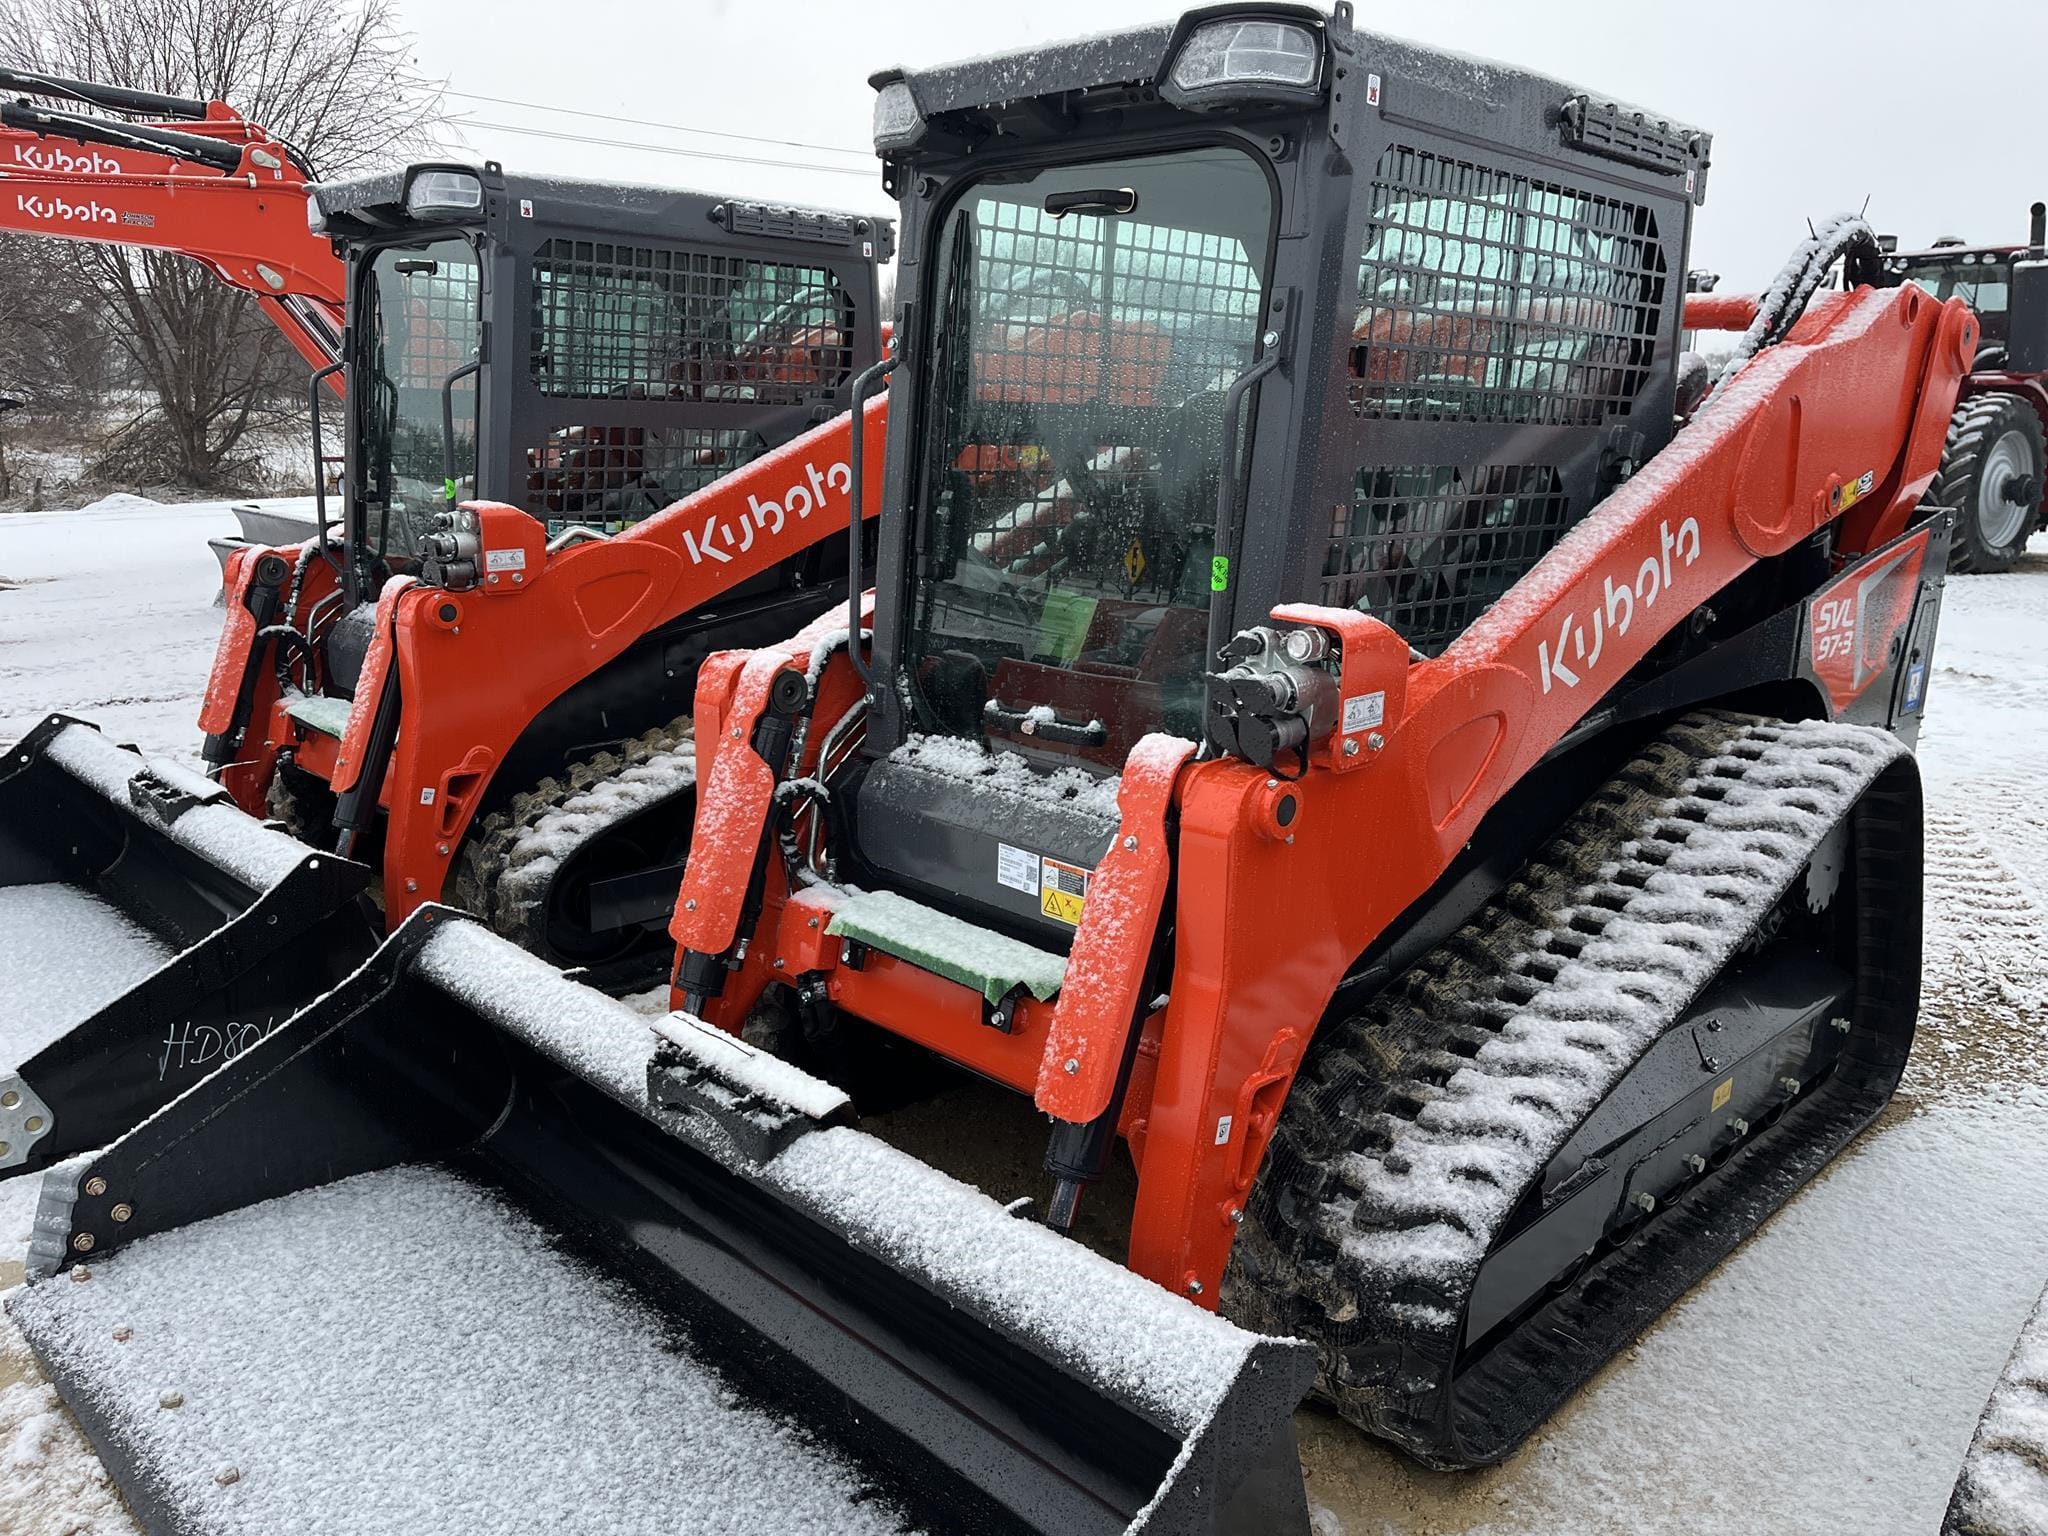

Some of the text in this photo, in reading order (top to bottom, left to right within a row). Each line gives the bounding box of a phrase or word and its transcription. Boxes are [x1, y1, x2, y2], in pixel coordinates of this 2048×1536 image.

[14, 145, 121, 175] Kubota
[17, 194, 118, 224] Kubota
[682, 462, 851, 565] Kubota
[1538, 516, 1700, 695] Kubota
[1815, 598, 1855, 634] SVL
